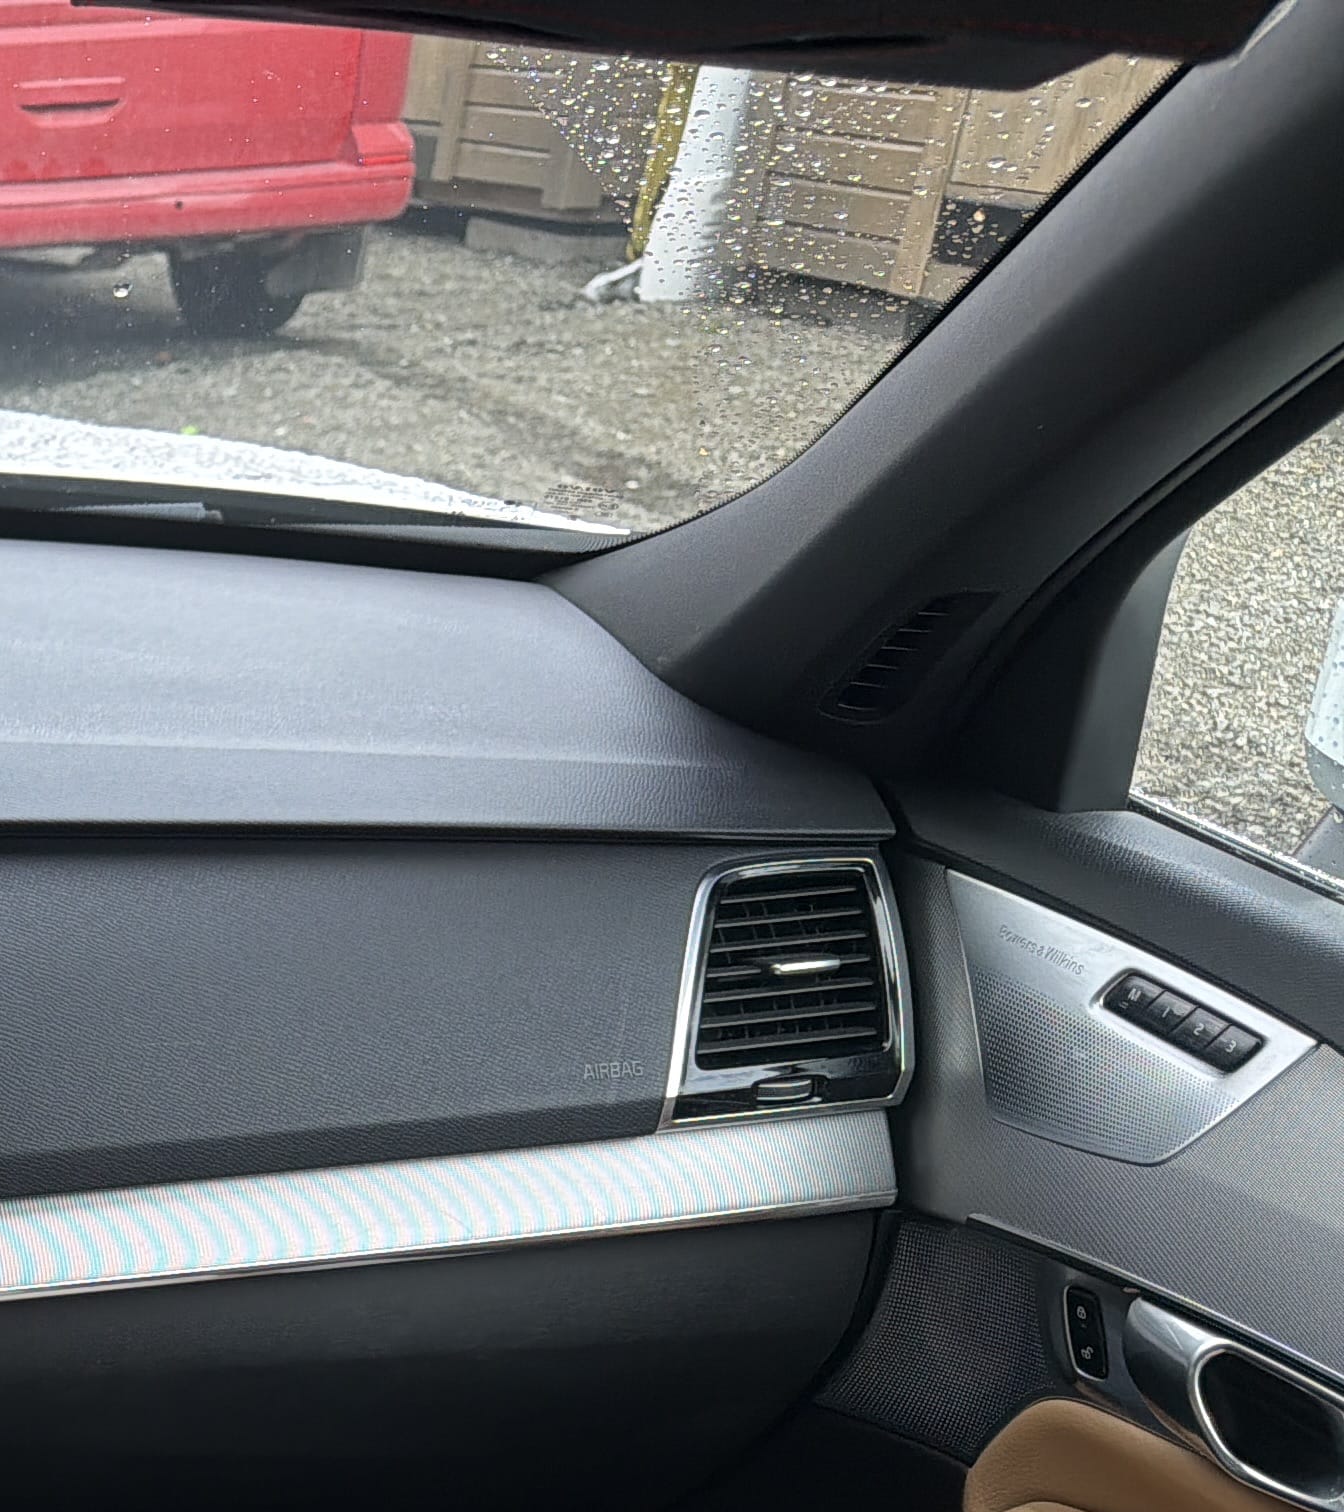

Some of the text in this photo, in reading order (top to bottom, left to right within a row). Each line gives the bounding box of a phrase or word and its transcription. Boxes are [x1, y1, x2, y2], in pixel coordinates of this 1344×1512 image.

[1194, 1024, 1206, 1036] 2
[1225, 1040, 1237, 1053] 3
[583, 1060, 645, 1080] AIRBAG
